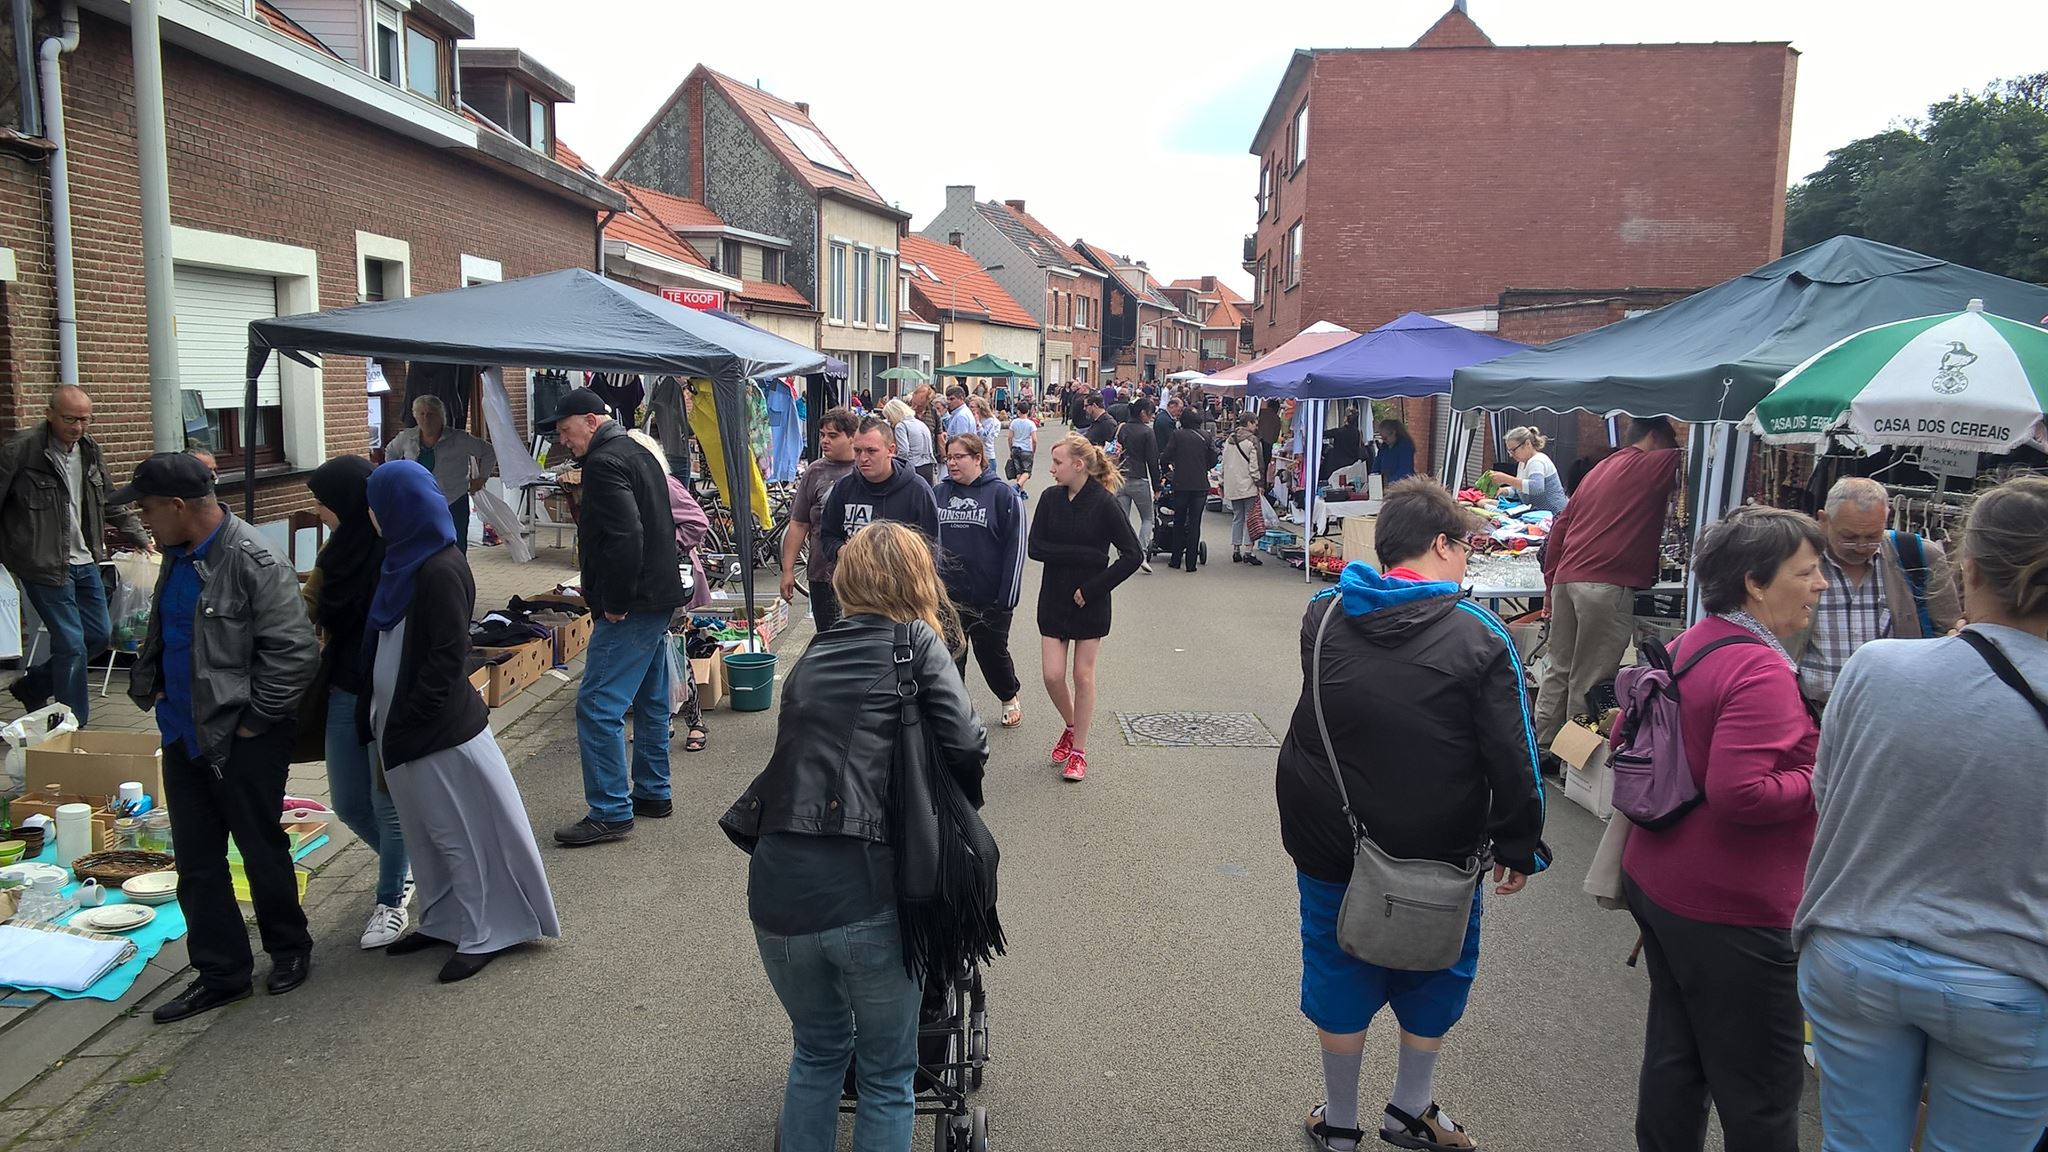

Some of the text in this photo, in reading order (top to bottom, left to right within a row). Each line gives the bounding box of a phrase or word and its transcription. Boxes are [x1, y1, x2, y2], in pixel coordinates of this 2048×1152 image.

[667, 291, 714, 304] TE KOOP
[1874, 418, 2011, 441] CASA DOS CEREAIS
[845, 505, 870, 523] JA
